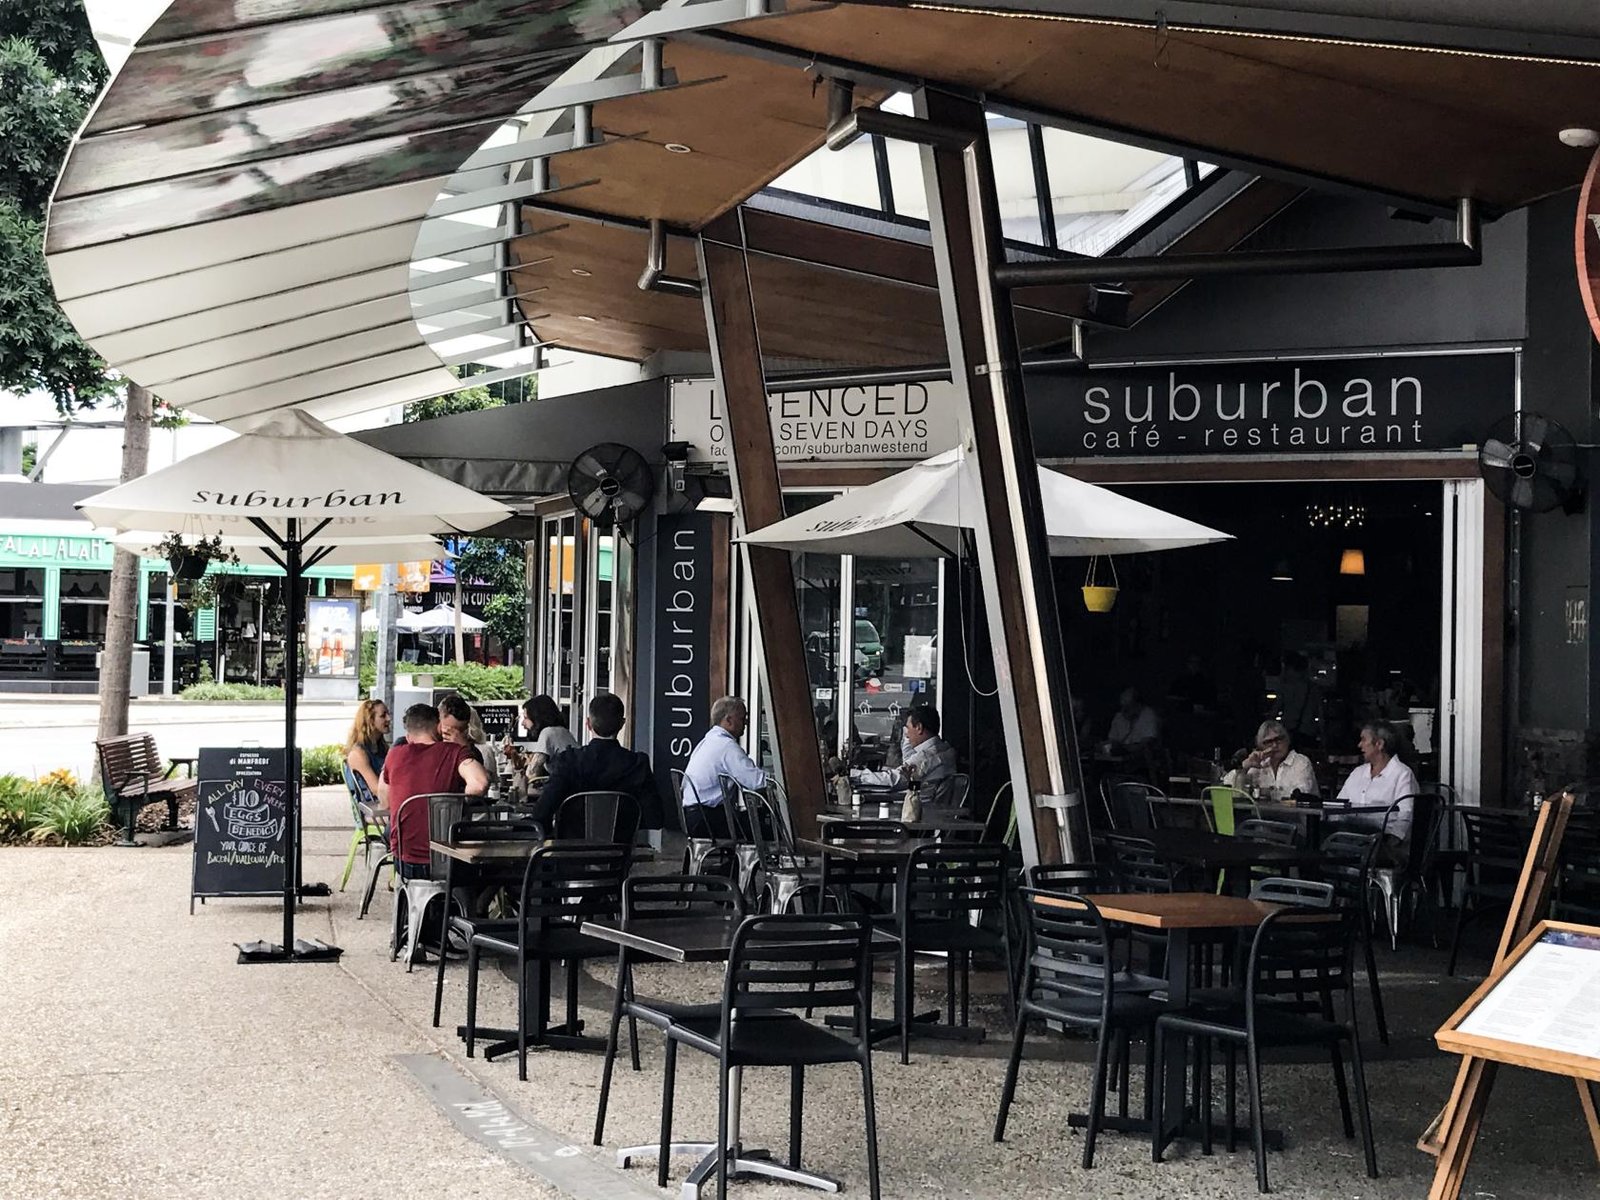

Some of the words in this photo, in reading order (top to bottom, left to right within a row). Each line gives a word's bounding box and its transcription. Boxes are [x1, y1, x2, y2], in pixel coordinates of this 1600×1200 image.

[709, 383, 928, 420] LENCED
[1083, 368, 1423, 424] suburban
[779, 421, 855, 441] SEVEN
[865, 419, 928, 438] DAYS
[1083, 425, 1160, 449] café
[1205, 420, 1422, 446] restaurant
[193, 489, 406, 508] suburban
[435, 592, 469, 605] INDIN
[665, 530, 695, 757] suburban
[207, 790, 226, 804] ALL
[225, 778, 244, 792] DAY
[253, 778, 286, 797] EVERY
[229, 809, 262, 822] EGGS
[231, 824, 274, 836] BENEDICT
